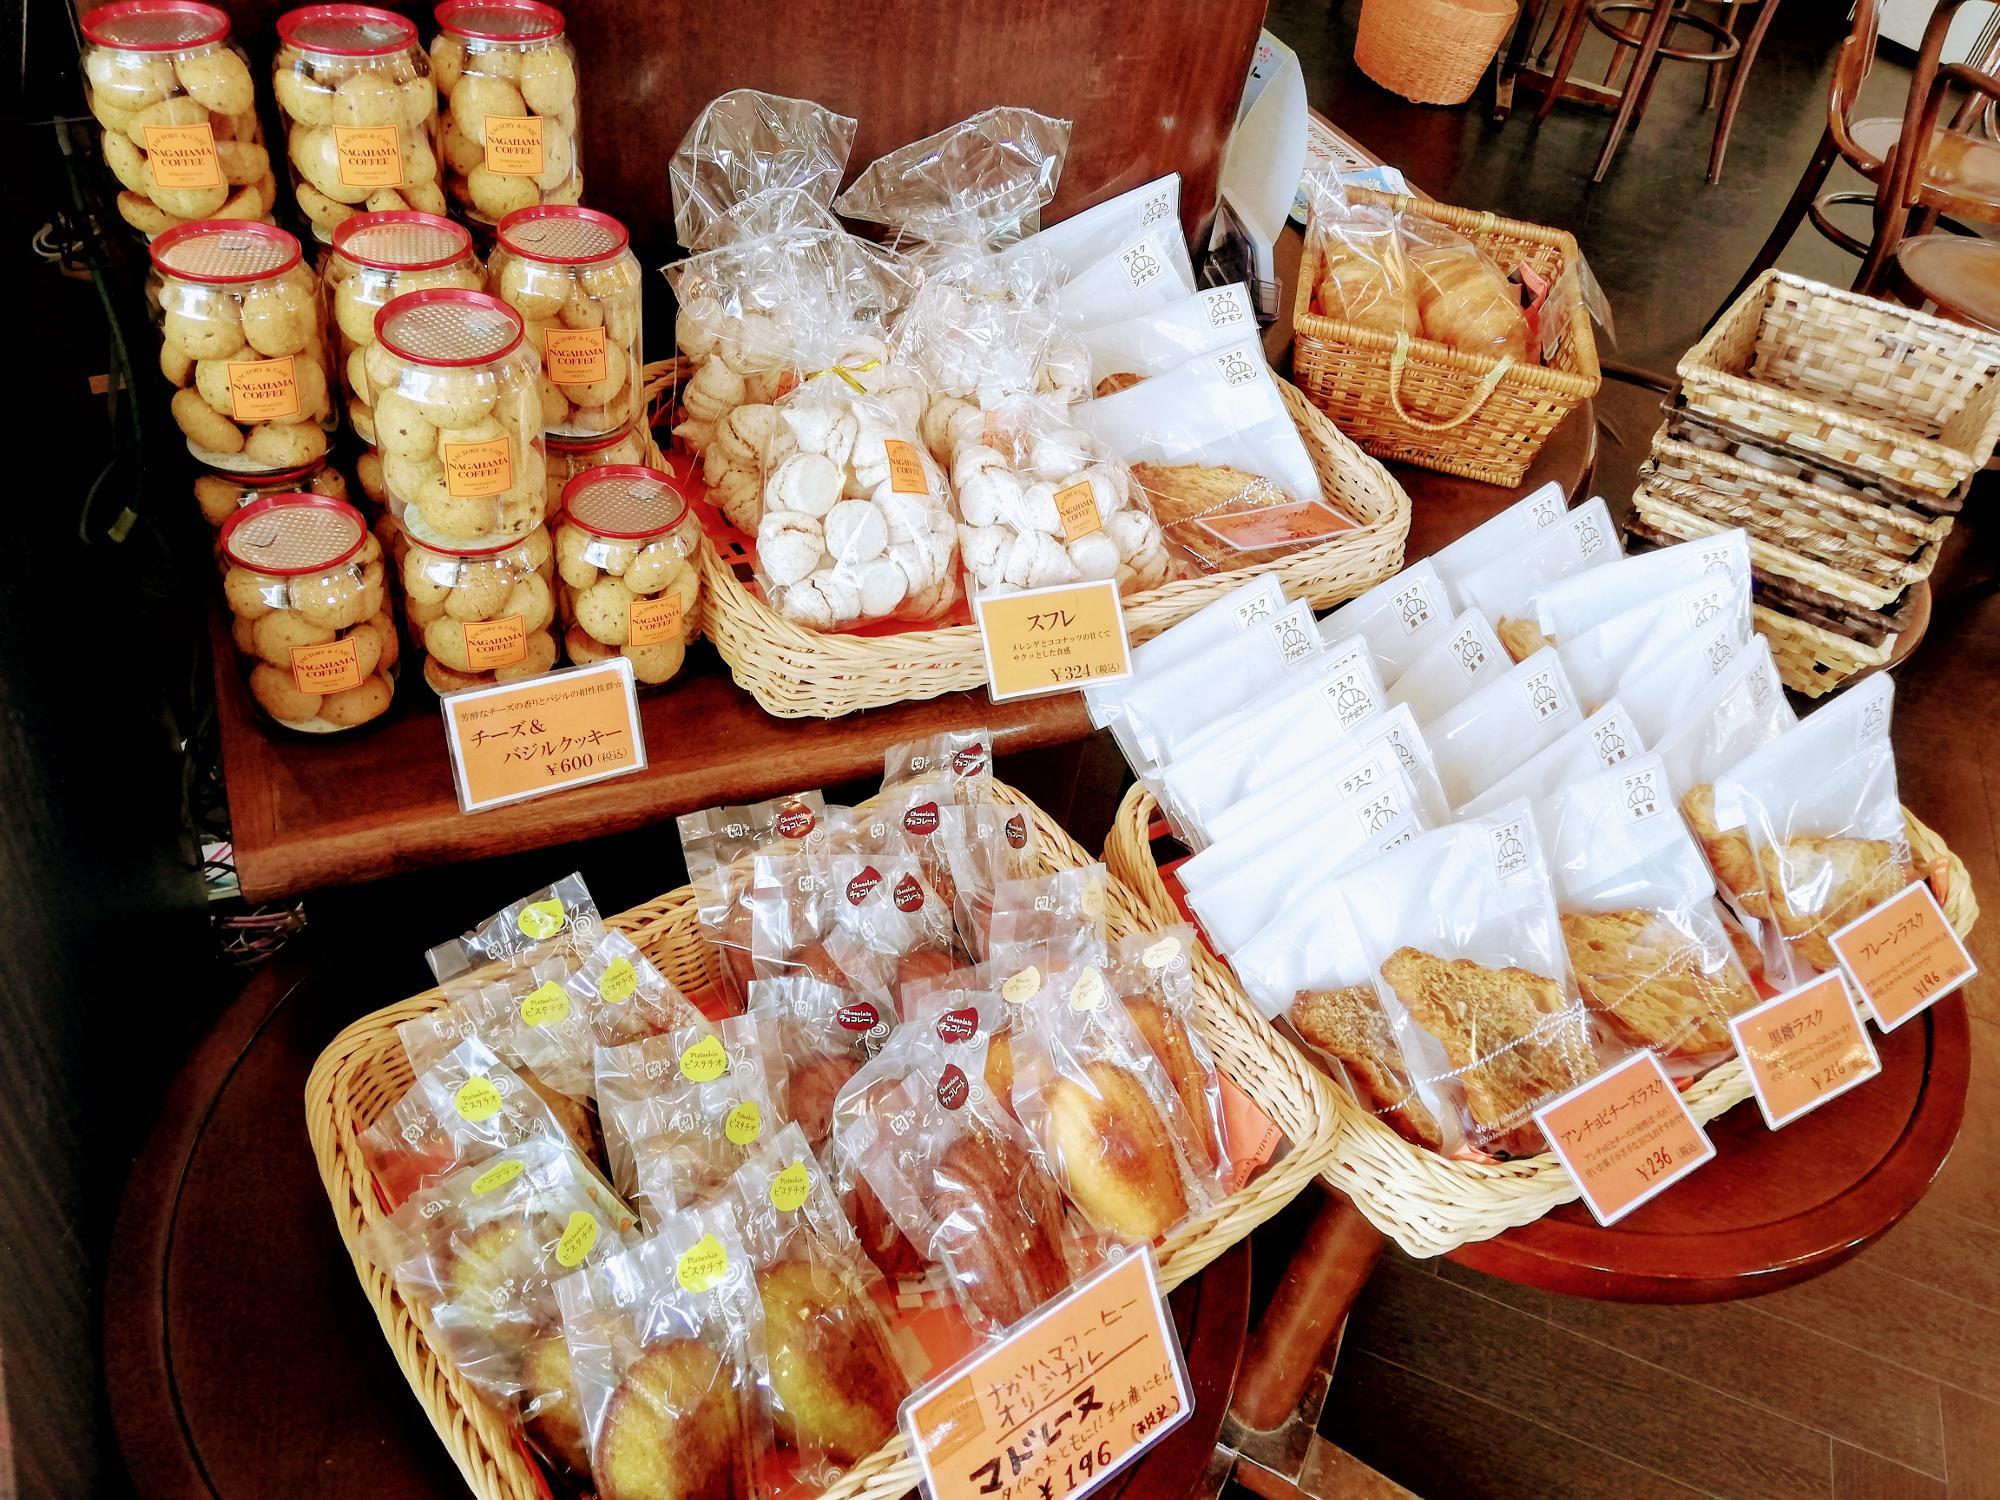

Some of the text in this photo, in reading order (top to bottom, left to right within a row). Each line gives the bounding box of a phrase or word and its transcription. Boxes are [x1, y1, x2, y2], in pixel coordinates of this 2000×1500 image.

[488, 136, 541, 146] NAGAHAMA
[151, 148, 213, 158] NAGAHAMA
[340, 148, 398, 157] NAGAHAMA
[495, 146, 534, 155] COFFEE
[348, 157, 391, 166] COFFEE
[1123, 244, 1146, 264] ラスク
[1133, 265, 1161, 287] シナモン
[1207, 291, 1233, 304] ラスク
[1212, 313, 1243, 326] シナモン
[550, 347, 603, 358] NAGAHAMA
[1219, 351, 1242, 365] ラスク
[557, 357, 596, 367] COFFEE
[233, 379, 294, 391] NAGAHAMA
[243, 389, 287, 401] COFFEE
[449, 457, 509, 471] NAGAHAMA
[457, 467, 502, 480] COFFEE
[1574, 515, 1593, 533] ラスク
[1396, 586, 1419, 607] ラスク
[1240, 598, 1266, 619] ラスク
[1027, 609, 1077, 632] スフレ
[1275, 616, 1298, 634] ラスク
[468, 632, 524, 648] NAGAHAMA
[476, 643, 519, 654] COFFEE
[297, 656, 356, 671] NAGAHAMA
[306, 667, 348, 679] COFFEE
[1328, 675, 1354, 697] ラスク
[1527, 673, 1548, 691] ラスク
[471, 718, 546, 748] チーズ&
[1594, 722, 1616, 742] ラスク
[503, 729, 623, 764] バジルクッキー
[1344, 768, 1372, 793] ラスク
[1625, 772, 1651, 791] ラスク
[1364, 795, 1389, 819] ラスク
[780, 819, 813, 833] チョコレート
[905, 817, 937, 826] チョコレート
[1495, 824, 1520, 842] ラスク
[851, 879, 878, 890] Chocolate
[895, 892, 921, 905] チョコレート
[1859, 911, 1925, 962] プレーンラスク
[839, 1016, 875, 1025] チョコレート
[843, 1009, 872, 1017] Chocolate
[946, 1014, 973, 1027] Chocolate
[939, 1022, 973, 1037] チョコレート
[1767, 1008, 1825, 1049] 黒糖ラスク
[940, 1080, 966, 1106] チョコレート
[1559, 1078, 1665, 1147] アンチョビチーズラスク
[998, 1350, 1105, 1428] オリジナル
[969, 1385, 1104, 1495] マドレーヌ
